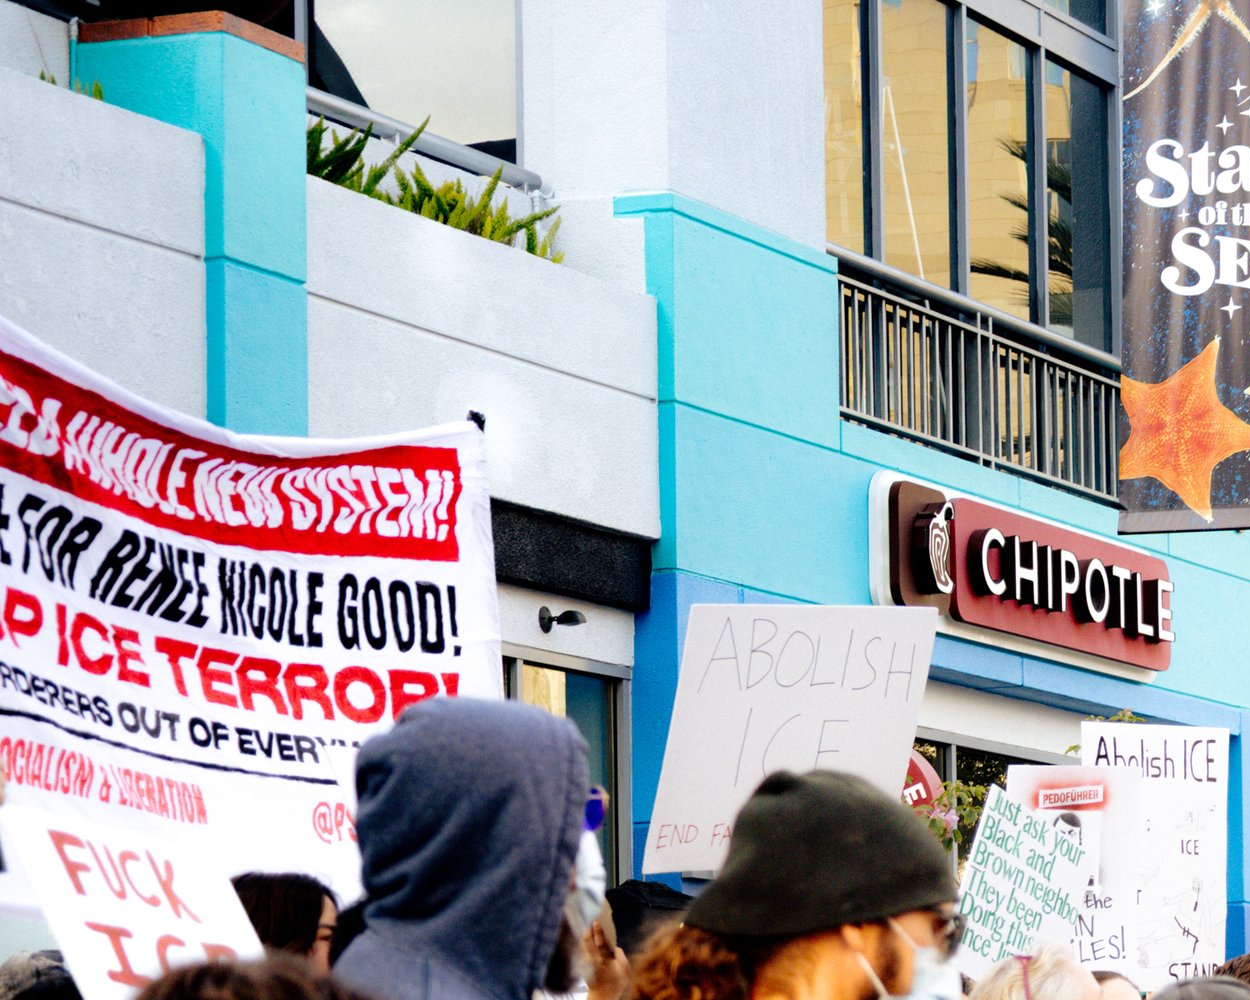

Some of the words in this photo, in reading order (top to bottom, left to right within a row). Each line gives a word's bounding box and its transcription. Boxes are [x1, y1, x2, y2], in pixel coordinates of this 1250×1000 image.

[1198, 201, 1228, 226] of
[63, 409, 200, 520] WHOLE
[193, 457, 291, 529] NEW
[280, 464, 455, 542] SYSTEM!
[18, 493, 103, 591] FOR
[89, 529, 210, 629] RENEE
[218, 556, 325, 647] NICOLE
[337, 572, 462, 657] GOOD!
[977, 527, 1176, 642] CHIPOTLE
[0, 586, 43, 649] P
[55, 602, 152, 689] ICE
[697, 617, 917, 702] ABOLISH
[117, 701, 181, 741] OUT
[188, 716, 231, 751] OF
[234, 726, 338, 764] EVER
[1183, 738, 1218, 783] ICE
[98, 764, 112, 804] &
[109, 763, 208, 825] LIBERATION
[656, 824, 699, 850] END
[981, 814, 1024, 860] Black
[1026, 848, 1057, 883] and
[989, 790, 1022, 827] Just
[1022, 815, 1050, 846] ask
[1049, 830, 1086, 867] your
[1180, 839, 1200, 856] ICE
[47, 828, 204, 925] FUCK
[972, 839, 1026, 889] Brown
[959, 891, 1006, 943] Doing
[971, 864, 1006, 915] They
[1006, 887, 1043, 932] been
[961, 927, 991, 958] nce
[1079, 925, 1127, 964] LES!
